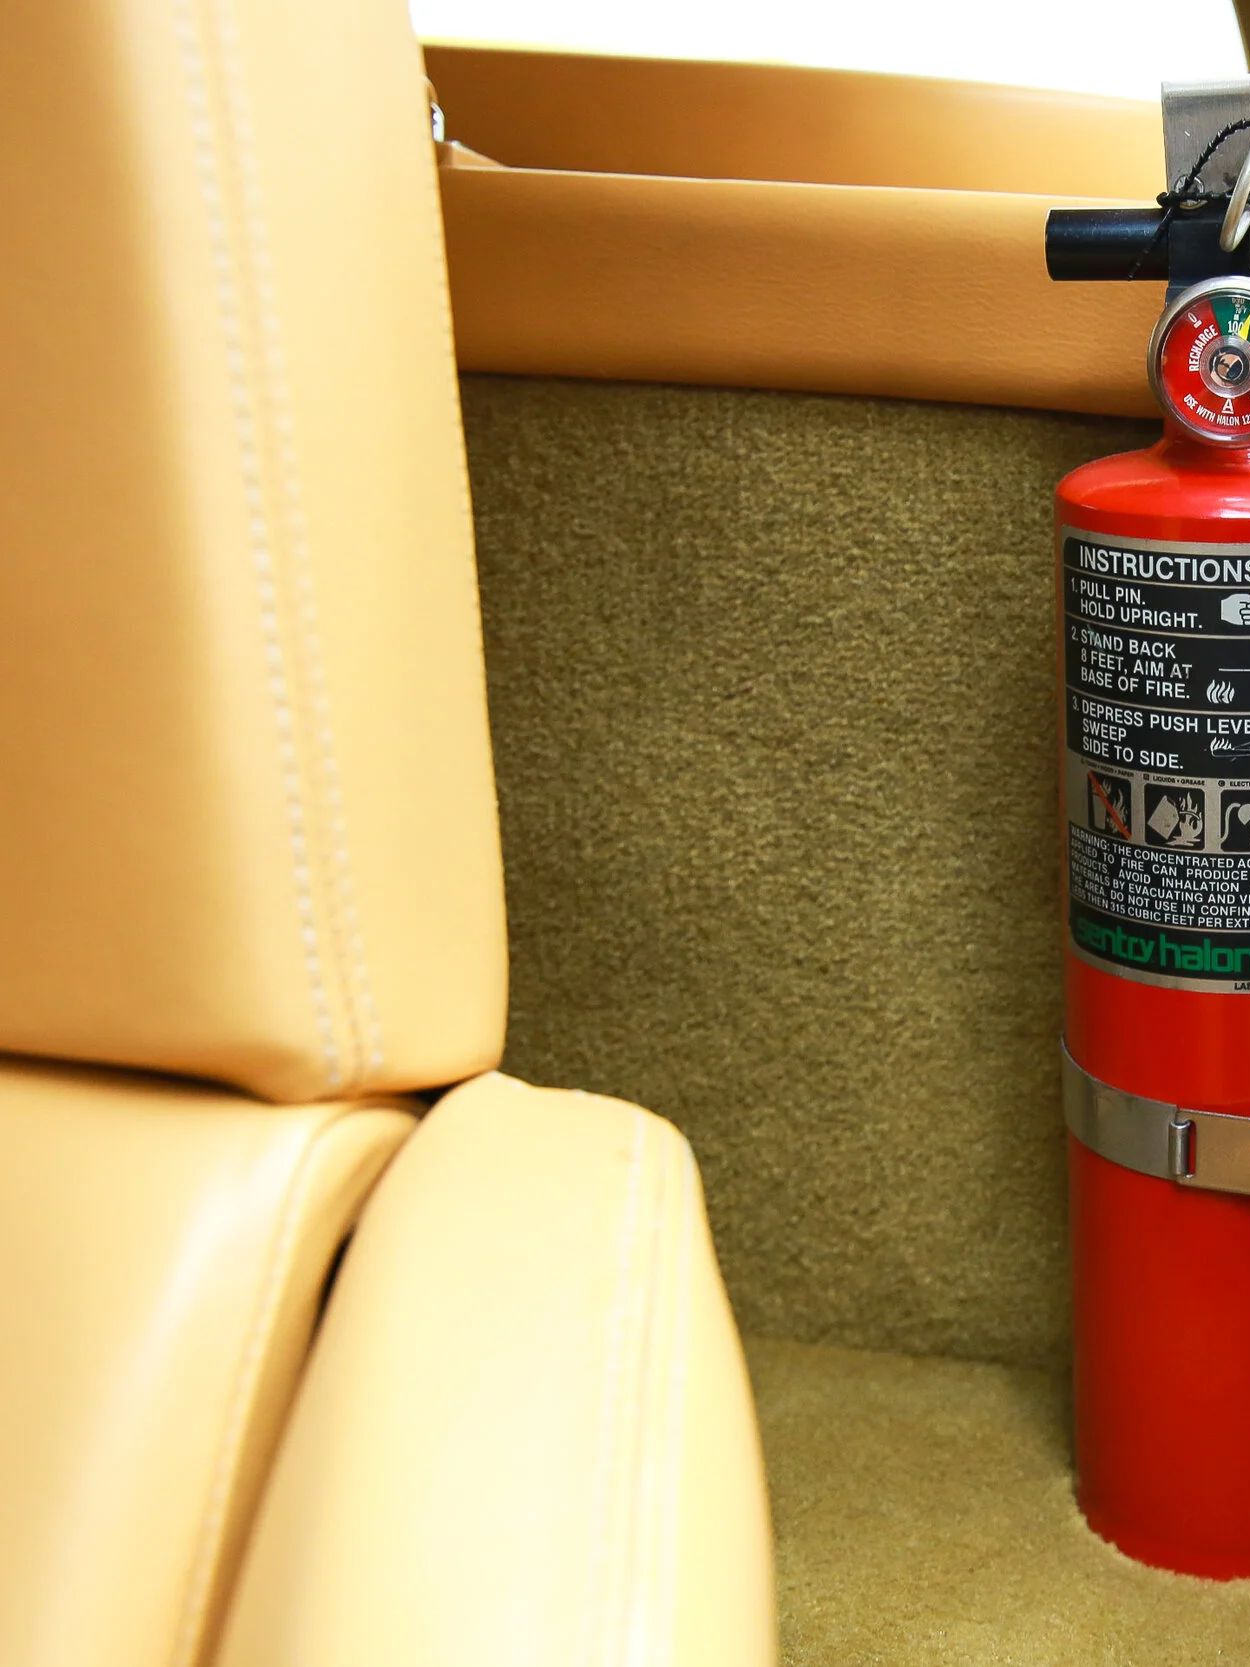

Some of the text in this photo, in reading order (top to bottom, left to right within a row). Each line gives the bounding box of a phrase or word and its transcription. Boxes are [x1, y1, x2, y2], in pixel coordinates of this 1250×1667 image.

[1189, 324, 1218, 372] RECHARGE
[1183, 394, 1196, 410] USE
[1196, 405, 1215, 422] WITH
[1216, 415, 1240, 426] HALON
[1071, 578, 1145, 605] 1. PULL PIN.
[1080, 599, 1203, 628] HOLD UPRIGHT.
[1071, 627, 1176, 659] 2. STAND BACK
[1081, 648, 1192, 679] 8 FEET, AIM AT
[1081, 666, 1190, 699] BASE OF FIRE.
[1072, 696, 1079, 711] 3.
[1082, 699, 1143, 726] DEPRESS
[1150, 714, 1198, 733] PUSH
[1082, 719, 1127, 743] SWEEP
[1082, 736, 1184, 769] SIDE TO SIDE.
[1071, 826, 1110, 852] WARNING:
[1112, 843, 1132, 858] THE
[1134, 847, 1234, 869] CONCENTRATED
[1071, 839, 1098, 858] APPLIED
[1102, 850, 1115, 864] TO
[1121, 856, 1144, 872] FIRE
[1152, 864, 1177, 876] CAN
[1186, 869, 1248, 880] PRODUCE
[1071, 849, 1109, 875] PRODUCTS.
[1119, 869, 1151, 884] AVOID
[1162, 878, 1239, 892] INHALATION
[1071, 861, 1110, 887] MATERIALS
[1113, 879, 1126, 890] BY
[1129, 883, 1203, 903] EVACUATING
[1207, 893, 1235, 904] AND
[1085, 880, 1107, 897] AREA.
[1111, 890, 1124, 902] DO
[1128, 895, 1149, 907] NOT
[1155, 901, 1177, 912] USE
[1183, 904, 1195, 913] IN
[1088, 894, 1108, 909] THEN
[1110, 902, 1126, 914] 315
[1128, 907, 1161, 921] CUBIC
[1164, 914, 1194, 926] FEET
[1198, 916, 1222, 928] PER
[1076, 917, 1155, 963] sentry
